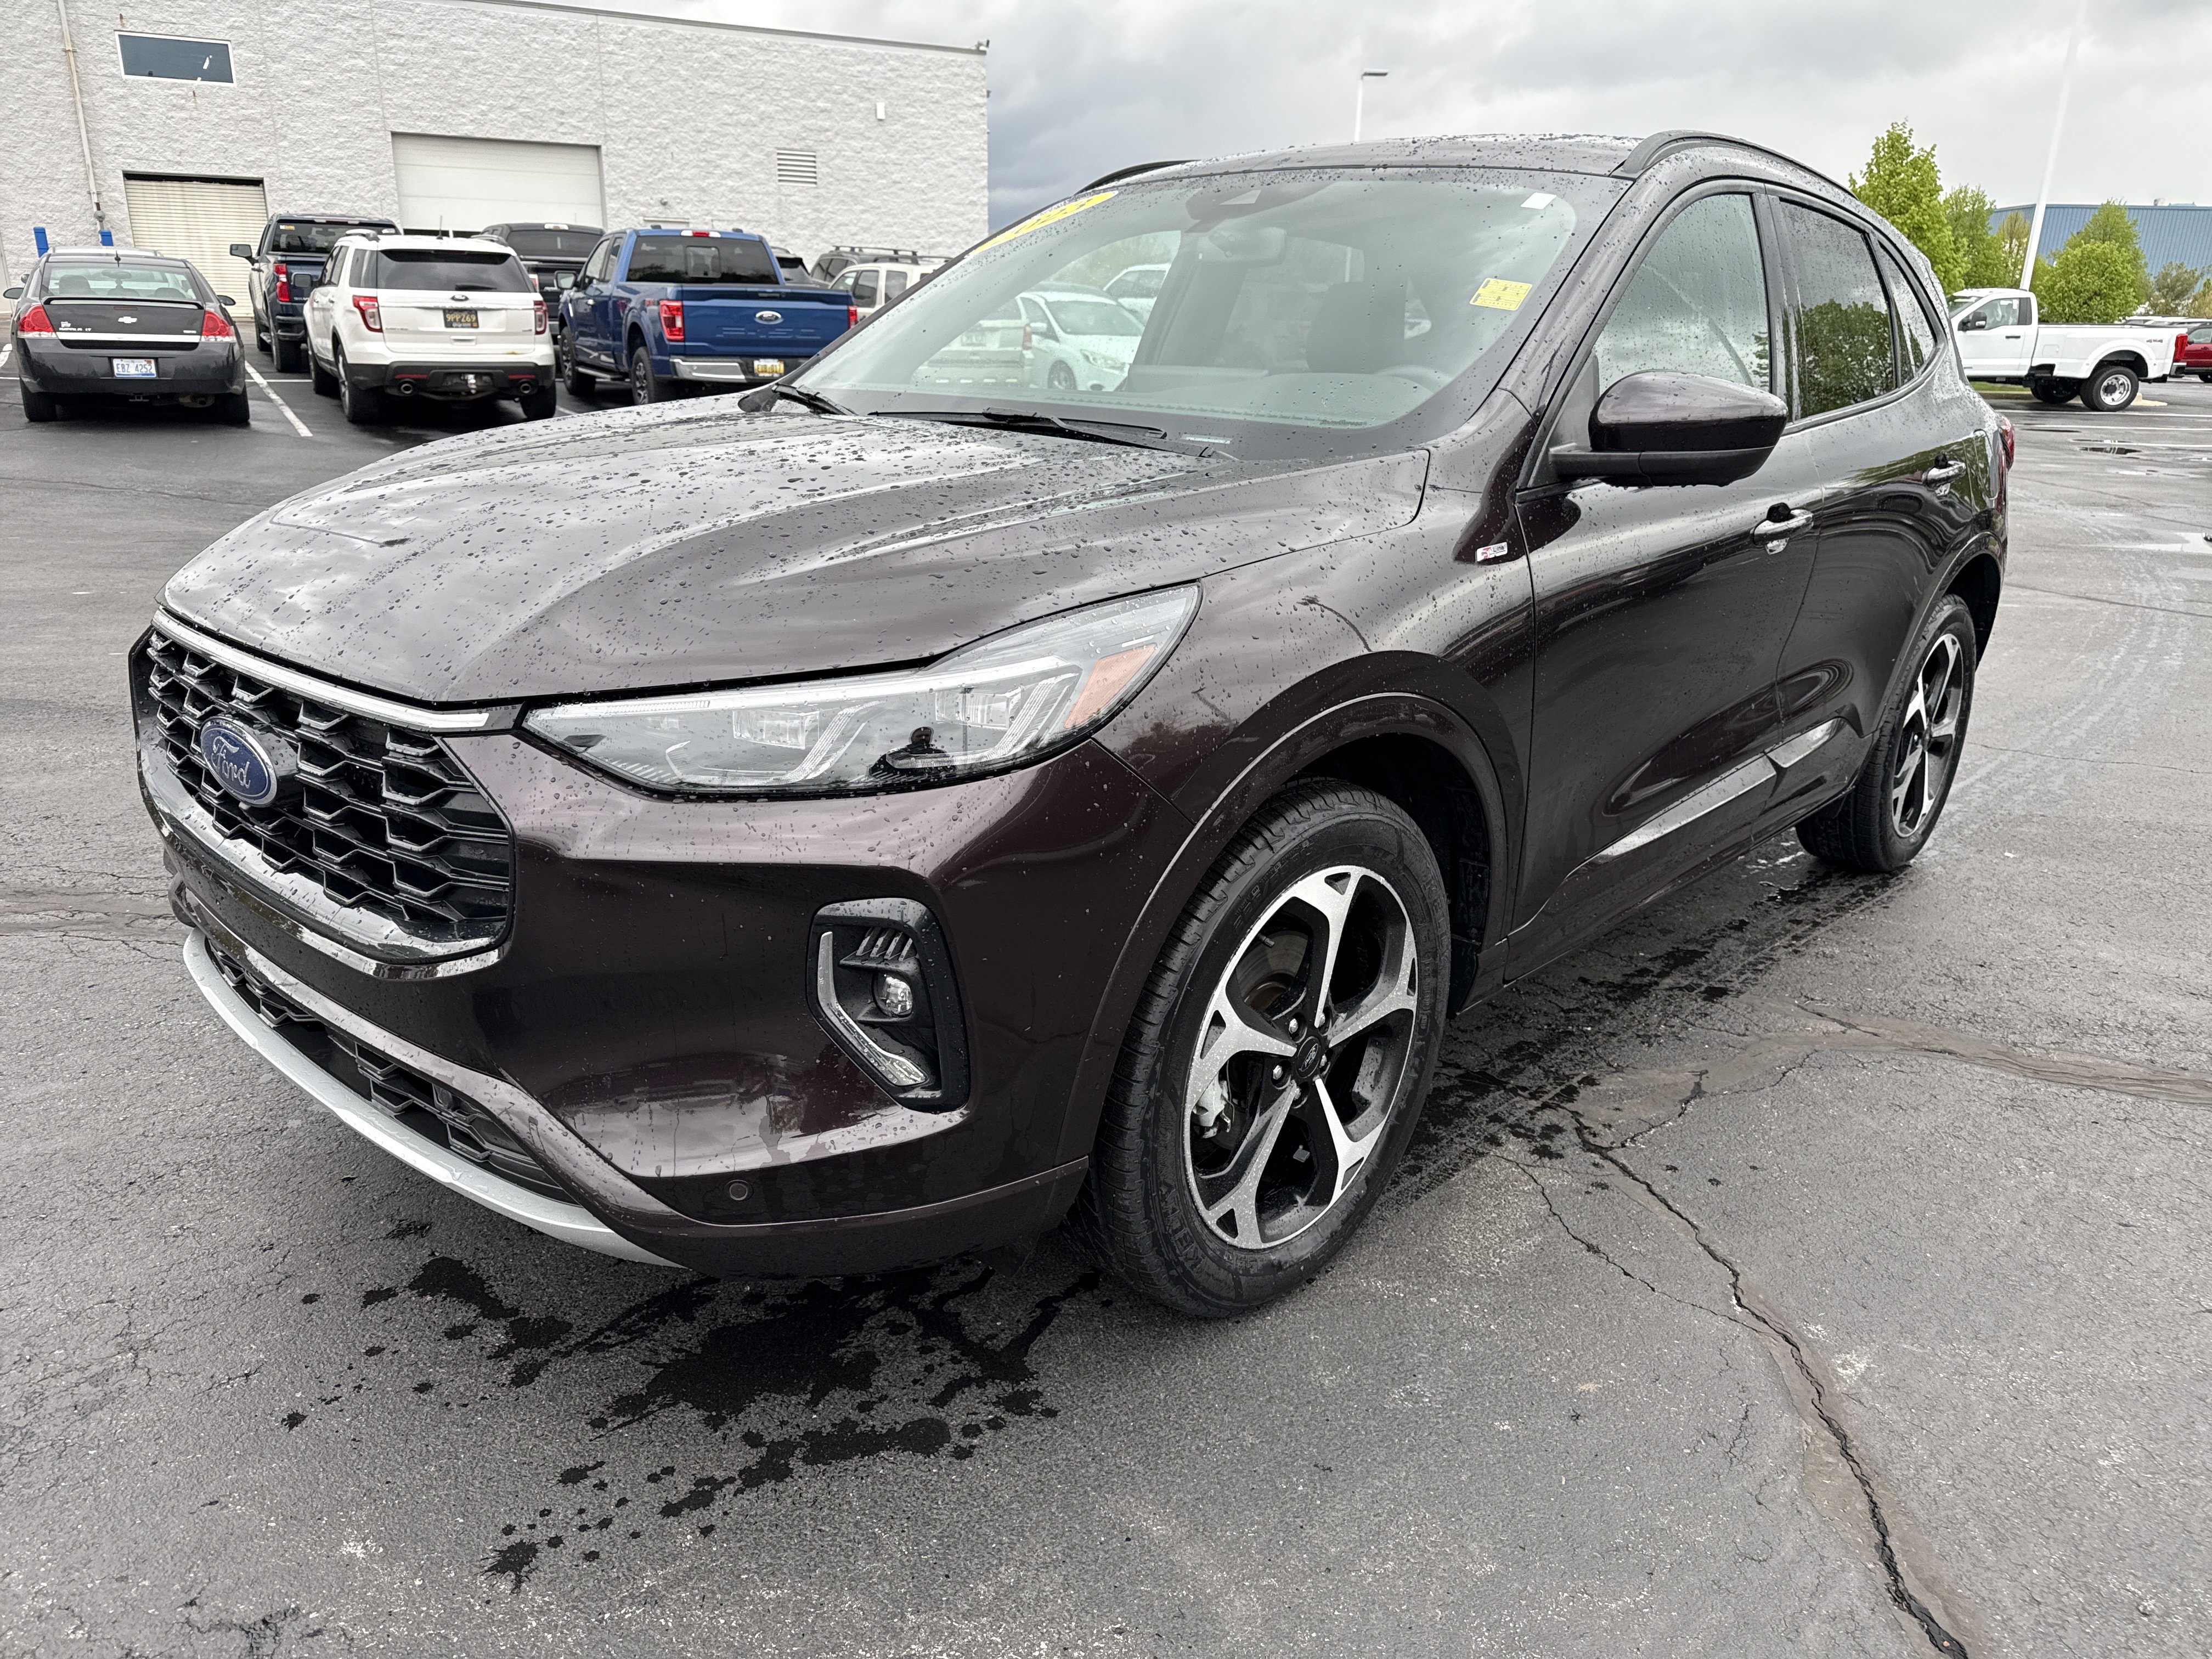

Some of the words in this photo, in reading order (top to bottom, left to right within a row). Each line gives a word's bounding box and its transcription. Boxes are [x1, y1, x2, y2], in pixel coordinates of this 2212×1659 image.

[116, 363, 131, 373] EBZ
[135, 364, 153, 373] 4252
[210, 736, 251, 789] Ford
